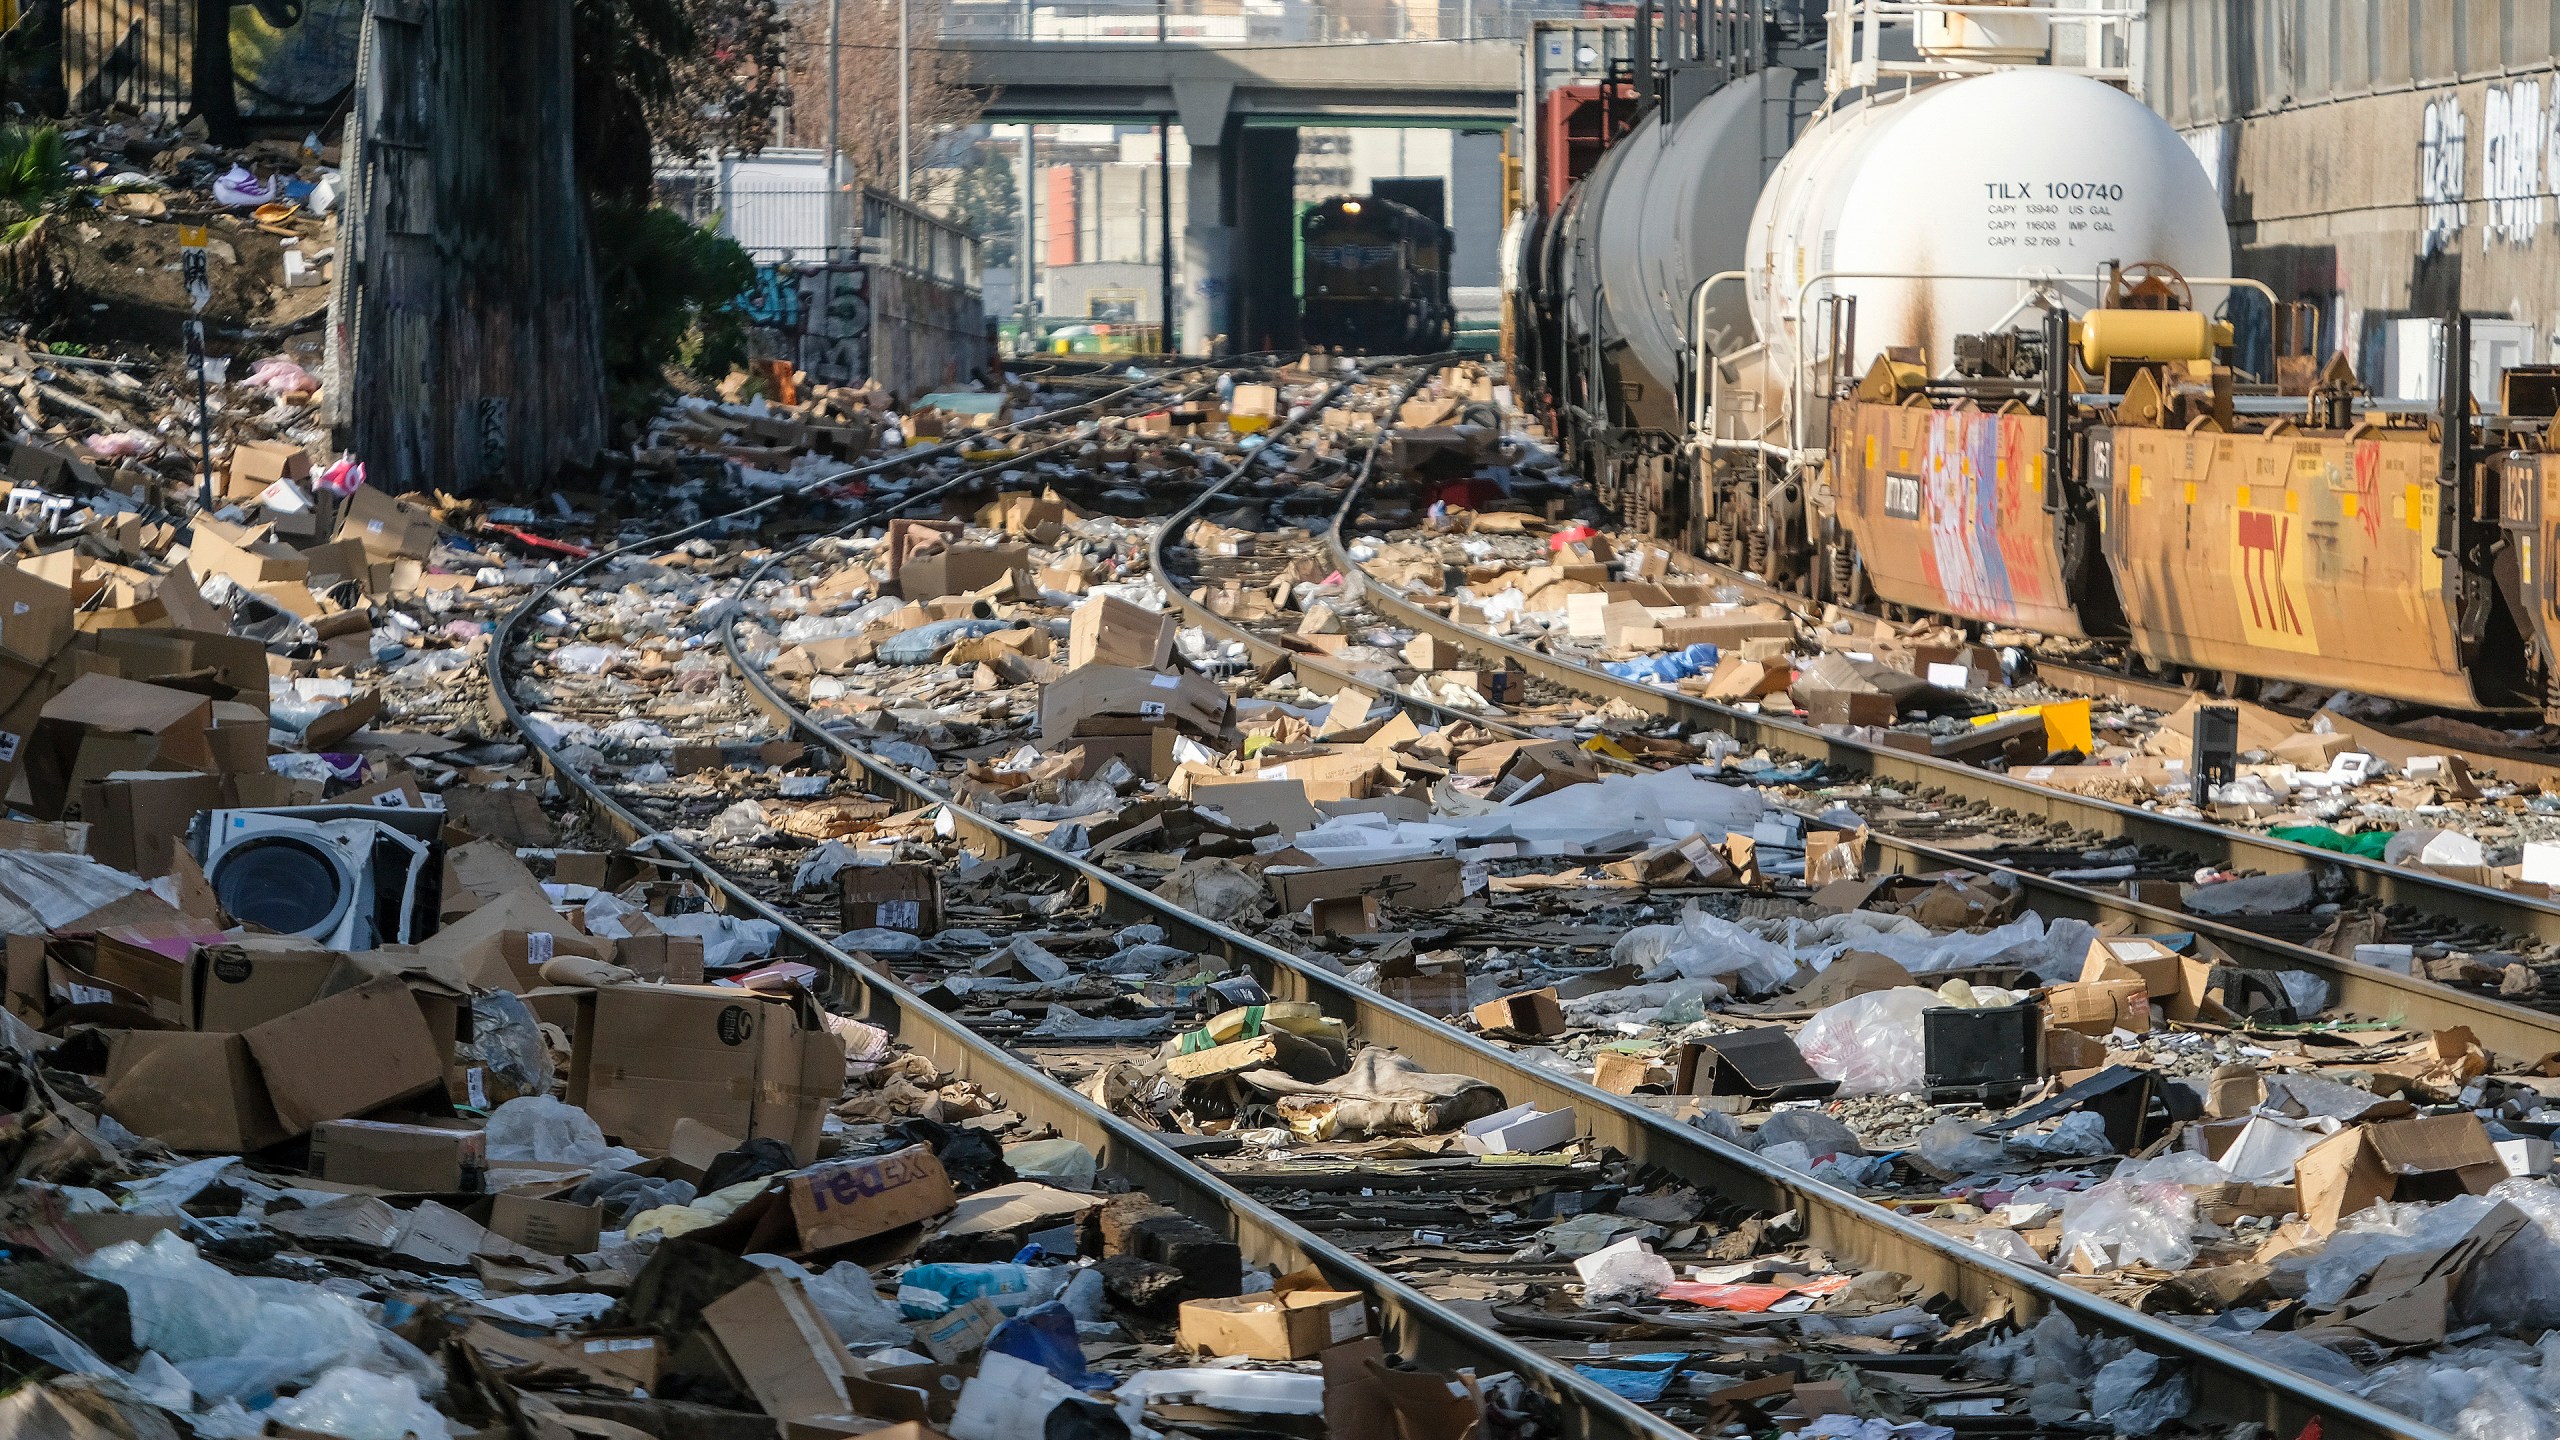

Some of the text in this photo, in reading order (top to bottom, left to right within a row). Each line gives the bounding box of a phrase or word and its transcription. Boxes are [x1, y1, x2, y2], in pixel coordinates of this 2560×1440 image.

[1985, 182, 2123, 201] TILX 100740
[1988, 205, 2112, 216] CAPY 13940 US GAL
[1988, 221, 2116, 232] CAPY 11608 IMP GAL
[1988, 237, 2016, 247] CAPY
